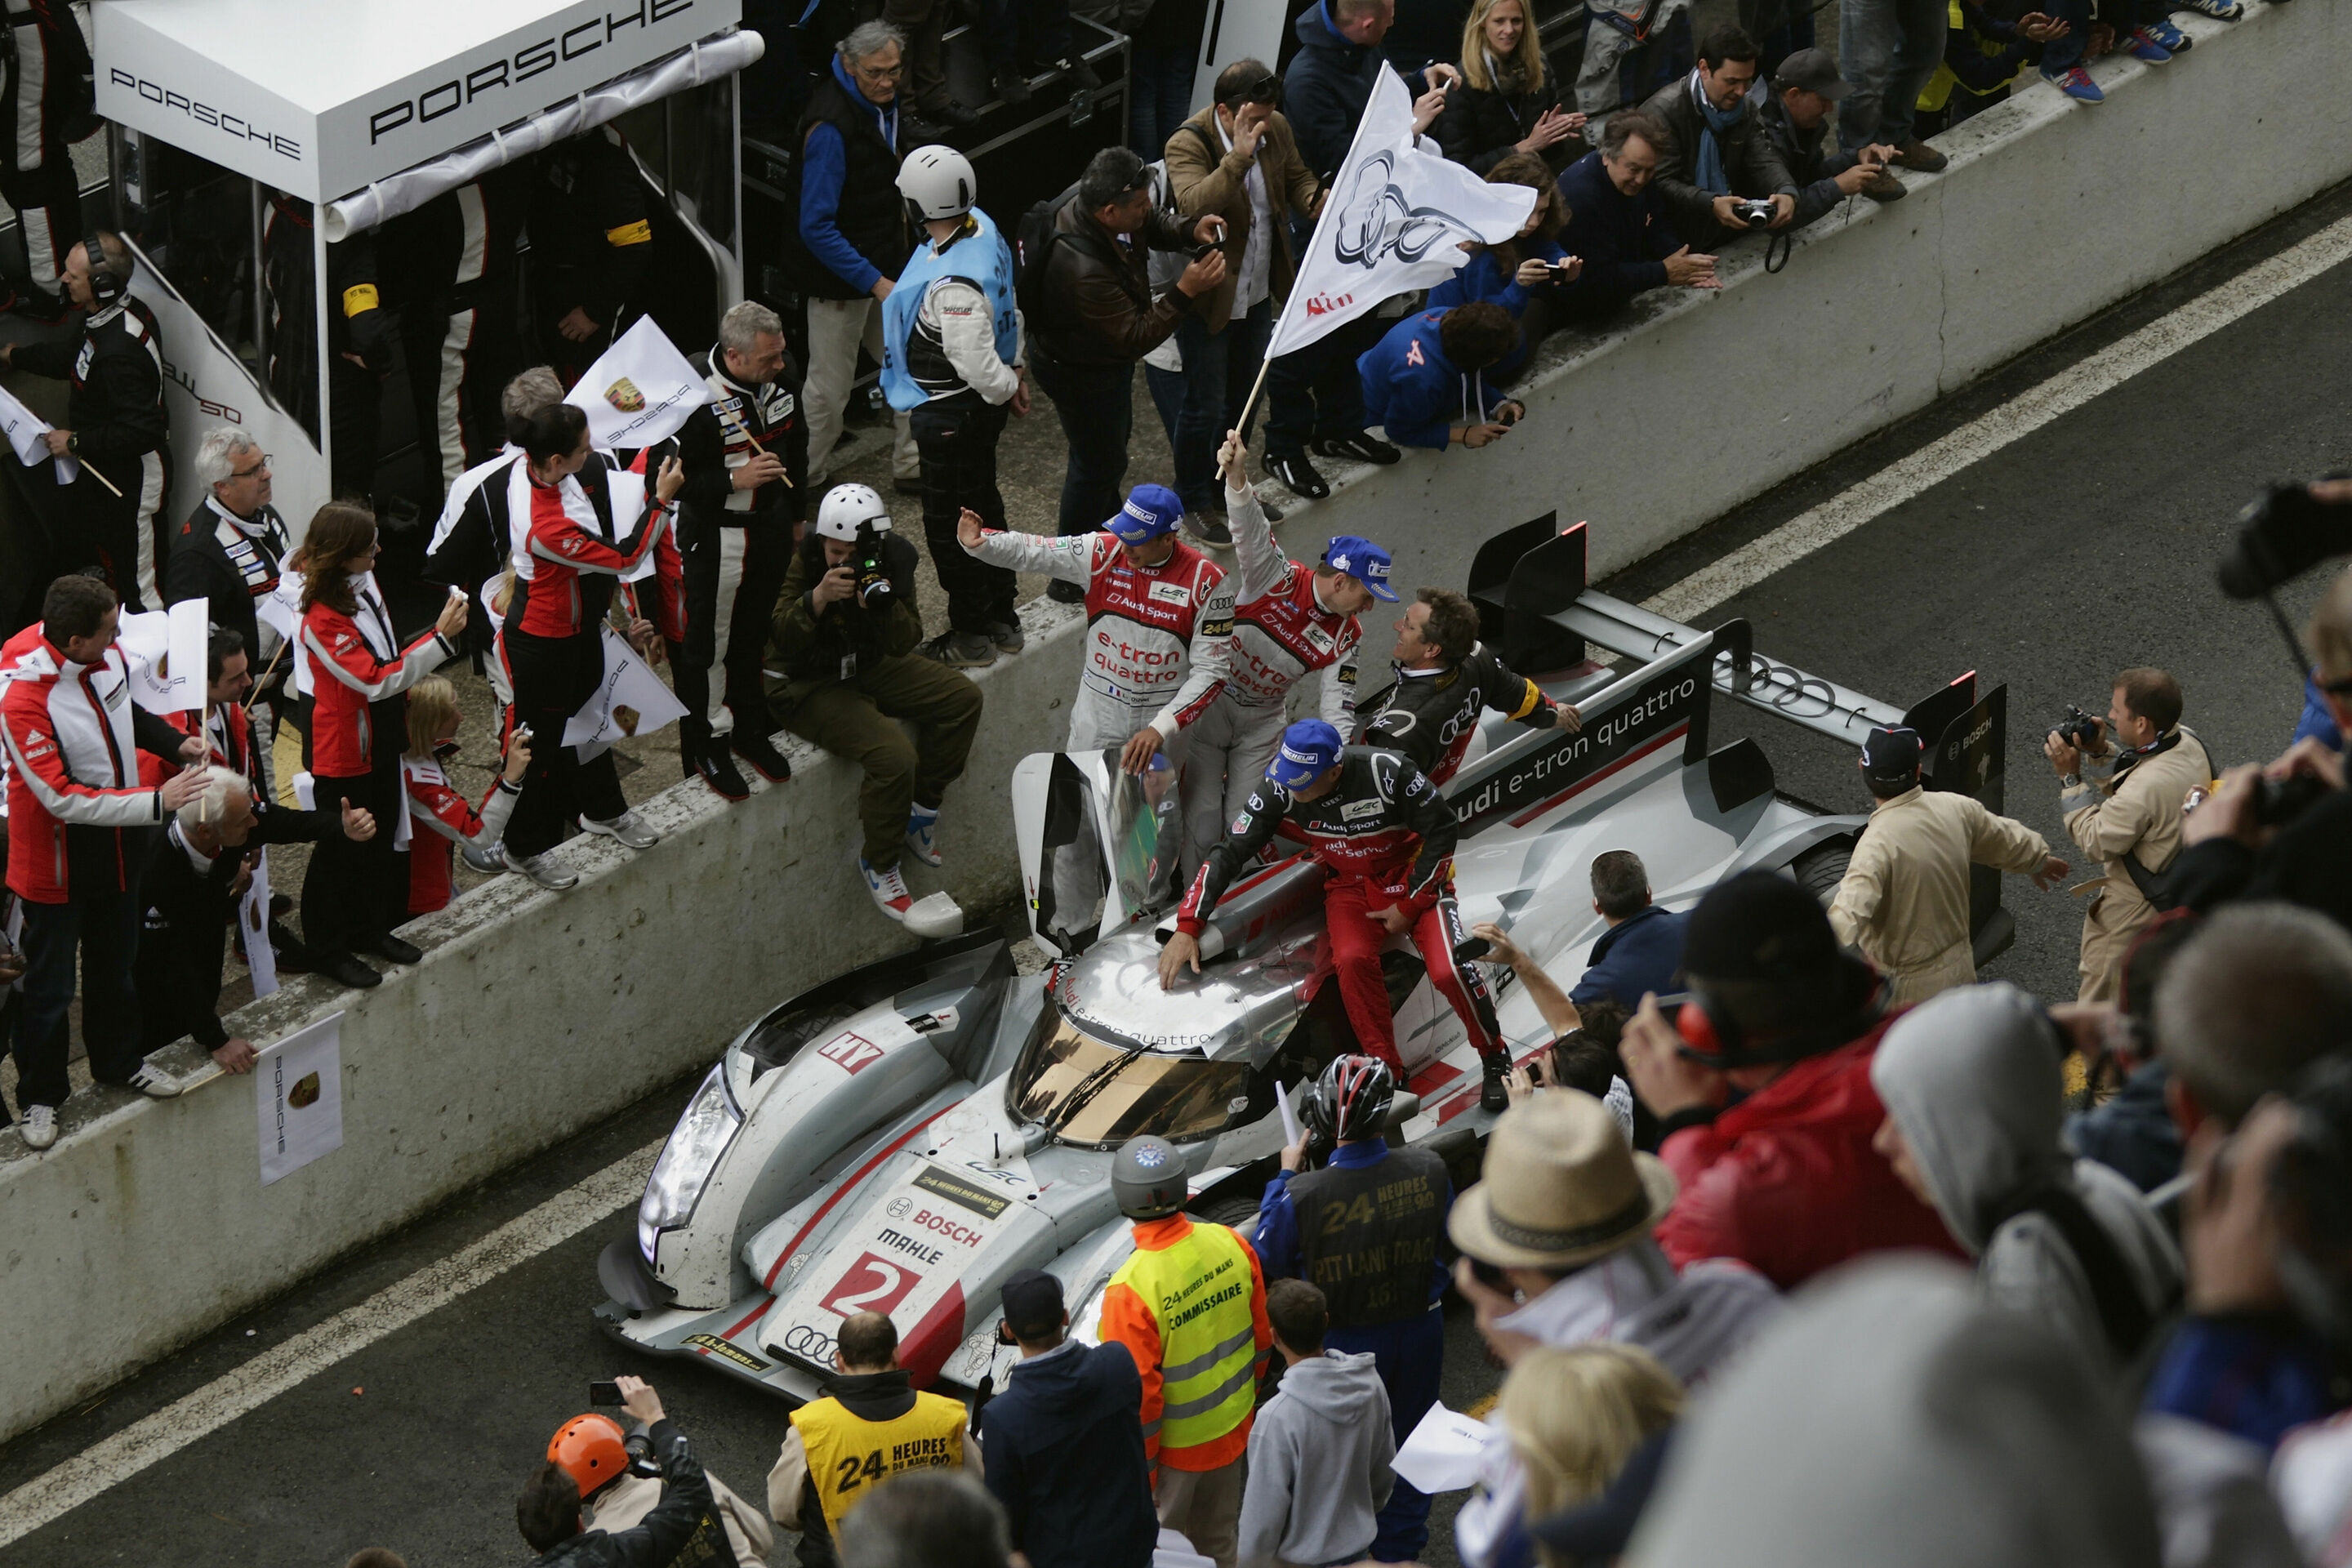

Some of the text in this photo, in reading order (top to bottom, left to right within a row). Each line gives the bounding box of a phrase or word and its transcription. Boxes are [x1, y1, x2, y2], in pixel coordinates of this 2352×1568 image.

[370, 0, 693, 145] PORSCHE
[111, 68, 301, 161] PORSCHE
[1121, 597, 1178, 621] Audi Sport
[1098, 631, 1181, 666] e-tron
[1297, 640, 1319, 662] Sport
[1094, 652, 1178, 684] quattro
[1458, 678, 1695, 823] udi e-tron quattro
[1962, 717, 1993, 750] BOSCH
[1349, 819, 1381, 832] Sport
[1066, 977, 1081, 1009] Audi
[821, 1031, 882, 1068] HY
[275, 1055, 286, 1156] PORSCHE
[919, 1176, 938, 1187] 24
[937, 1181, 964, 1194] HEURES
[961, 1189, 973, 1197] DU
[972, 1192, 993, 1205] MANS
[965, 1161, 1027, 1186] WEC
[1322, 1192, 1375, 1236] 24
[1377, 1175, 1428, 1204] HEURES
[877, 1228, 943, 1265] MAHLE
[913, 1209, 982, 1248] BOSCH
[1163, 1258, 1234, 1312] 24 HEURES DU MANS
[1316, 1254, 1343, 1284] PIT
[831, 1261, 901, 1318] 2
[1169, 1282, 1242, 1330] COMMISSAIRE
[836, 1437, 947, 1495] 24 HEURES
[893, 1462, 904, 1471] DU
[907, 1456, 929, 1468] MANS
